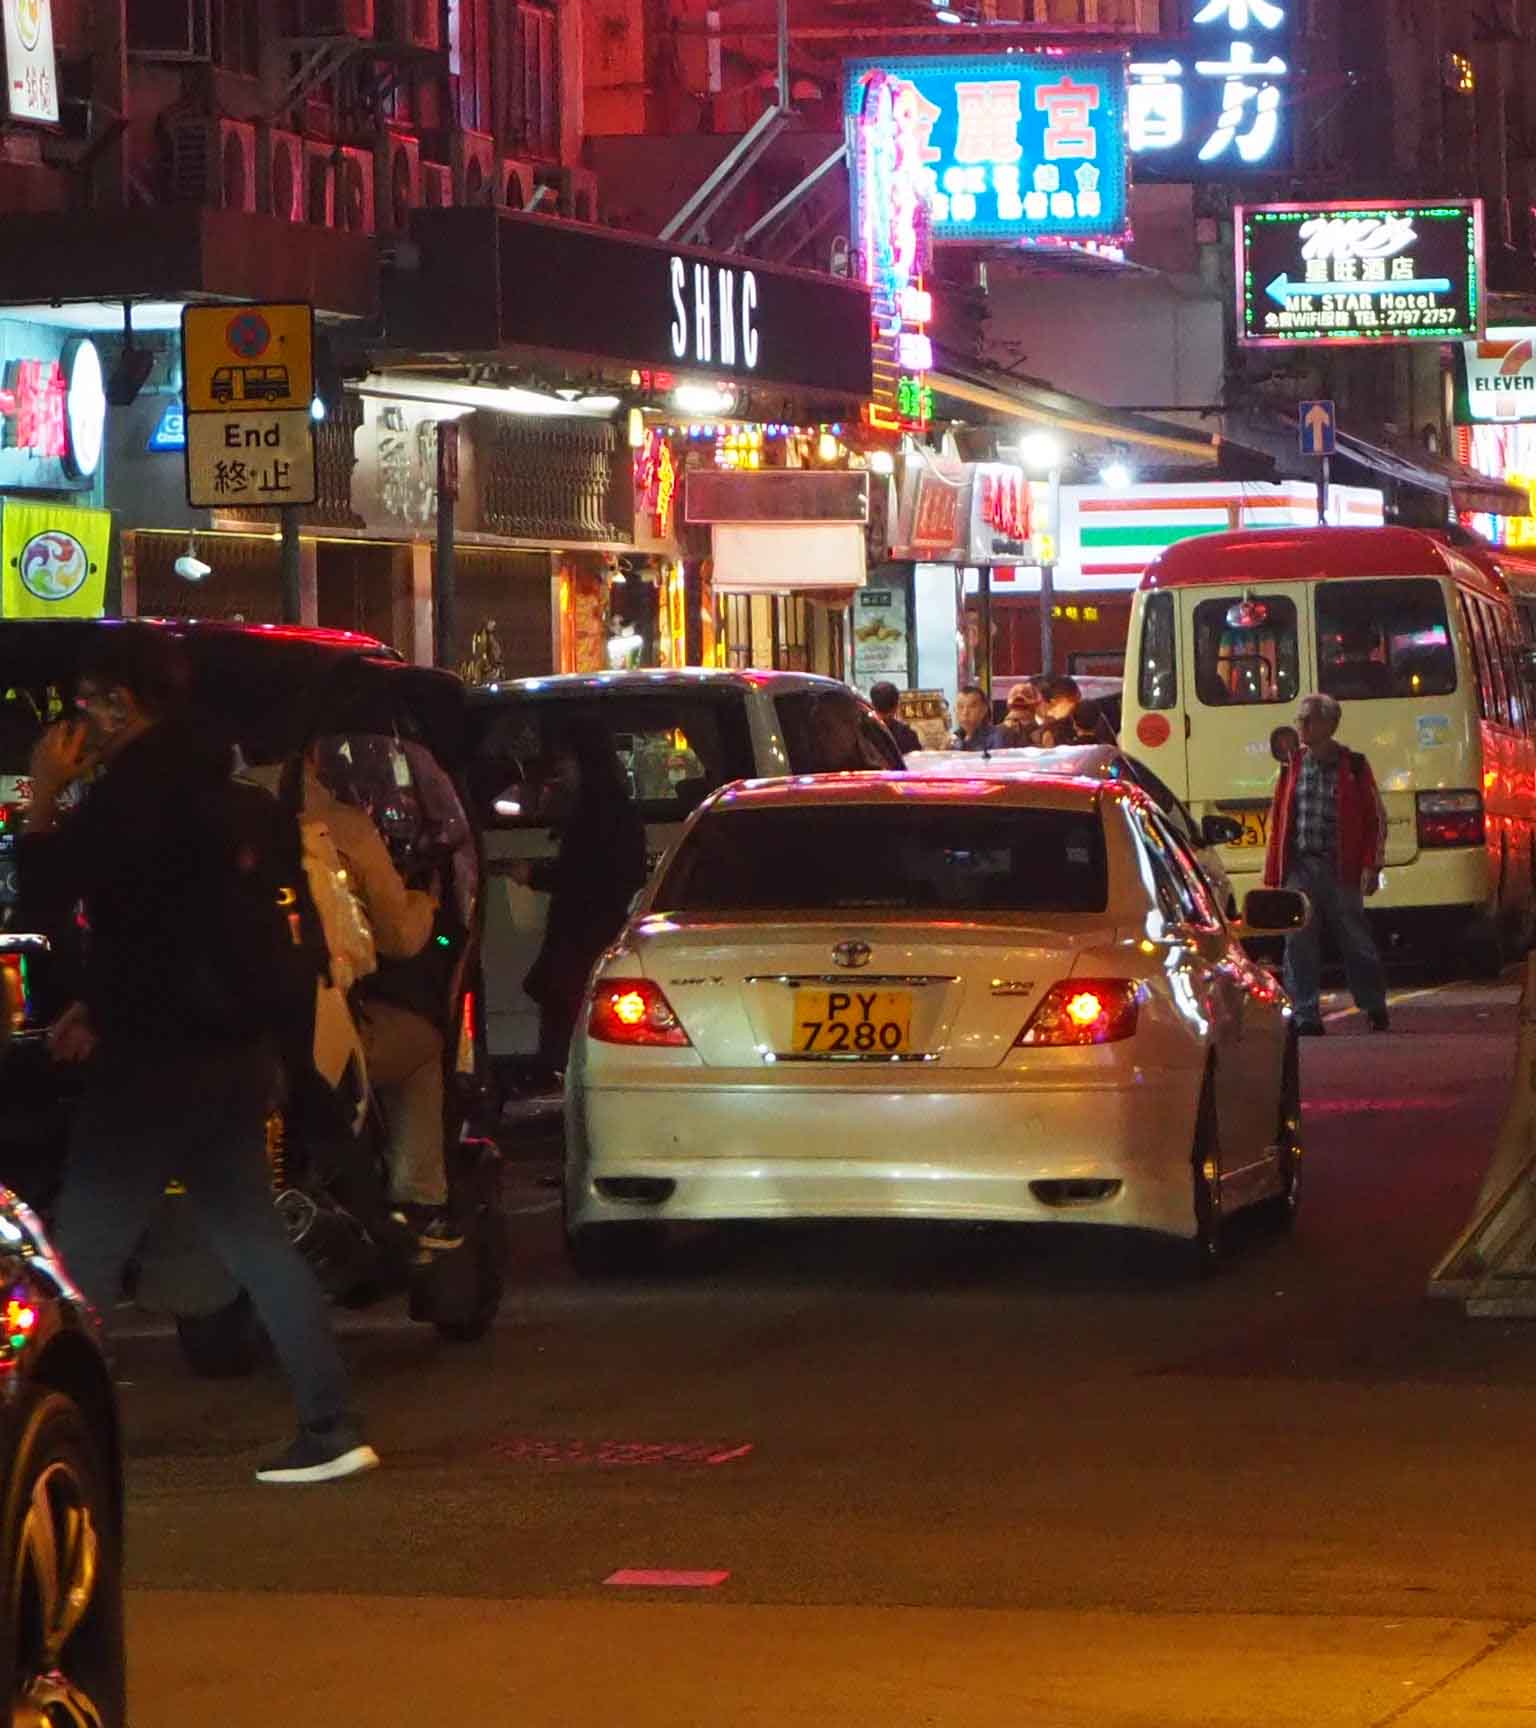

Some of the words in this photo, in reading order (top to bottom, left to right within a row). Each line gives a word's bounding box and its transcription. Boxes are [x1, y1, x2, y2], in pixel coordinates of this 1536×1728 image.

[1322, 294, 1372, 310] STAR
[1380, 292, 1436, 310] Hotel
[1422, 307, 1456, 323] 2757
[225, 424, 280, 447] End
[214, 459, 292, 494] 終止
[828, 993, 877, 1021] PY
[801, 1021, 902, 1051] 7280
